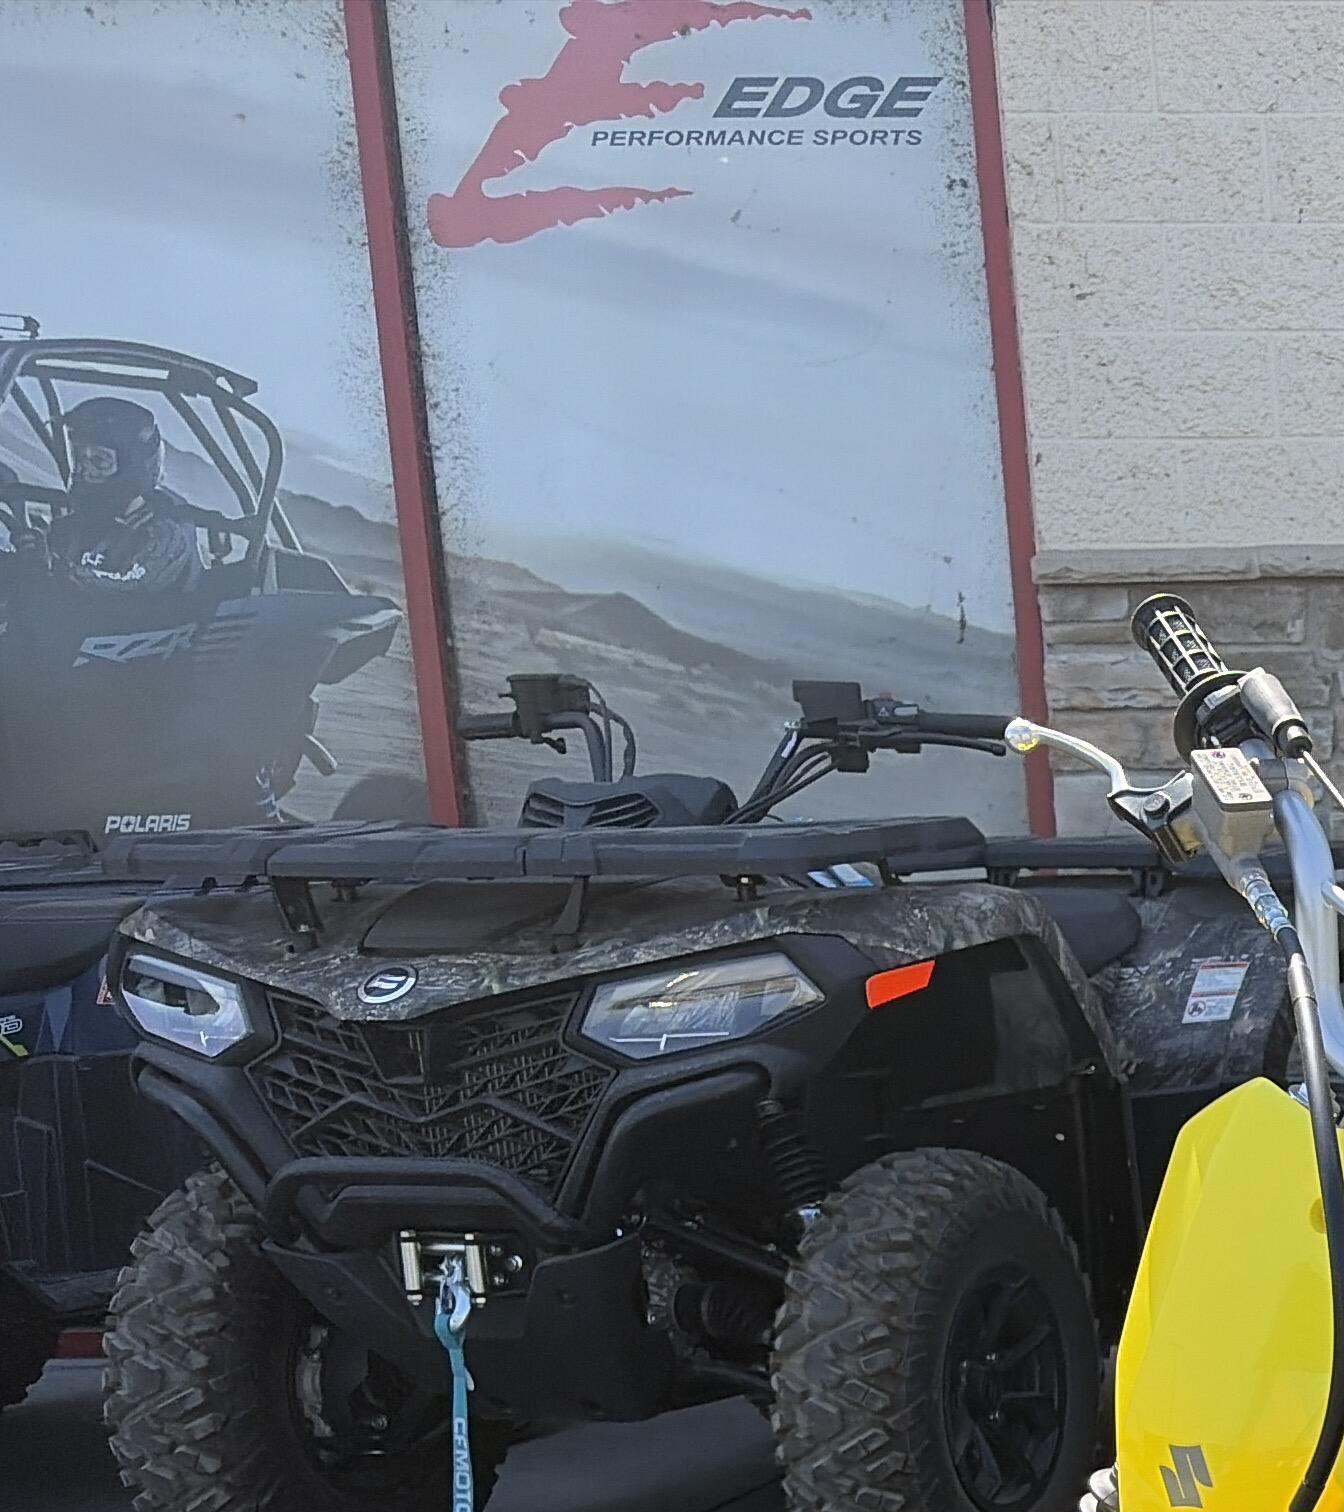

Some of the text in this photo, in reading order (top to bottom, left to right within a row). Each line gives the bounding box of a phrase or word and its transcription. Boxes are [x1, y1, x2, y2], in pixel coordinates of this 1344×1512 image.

[712, 77, 943, 119] EDGE
[591, 129, 923, 147] PERFORMANCE SPORTS
[105, 814, 191, 834] POLARIS
